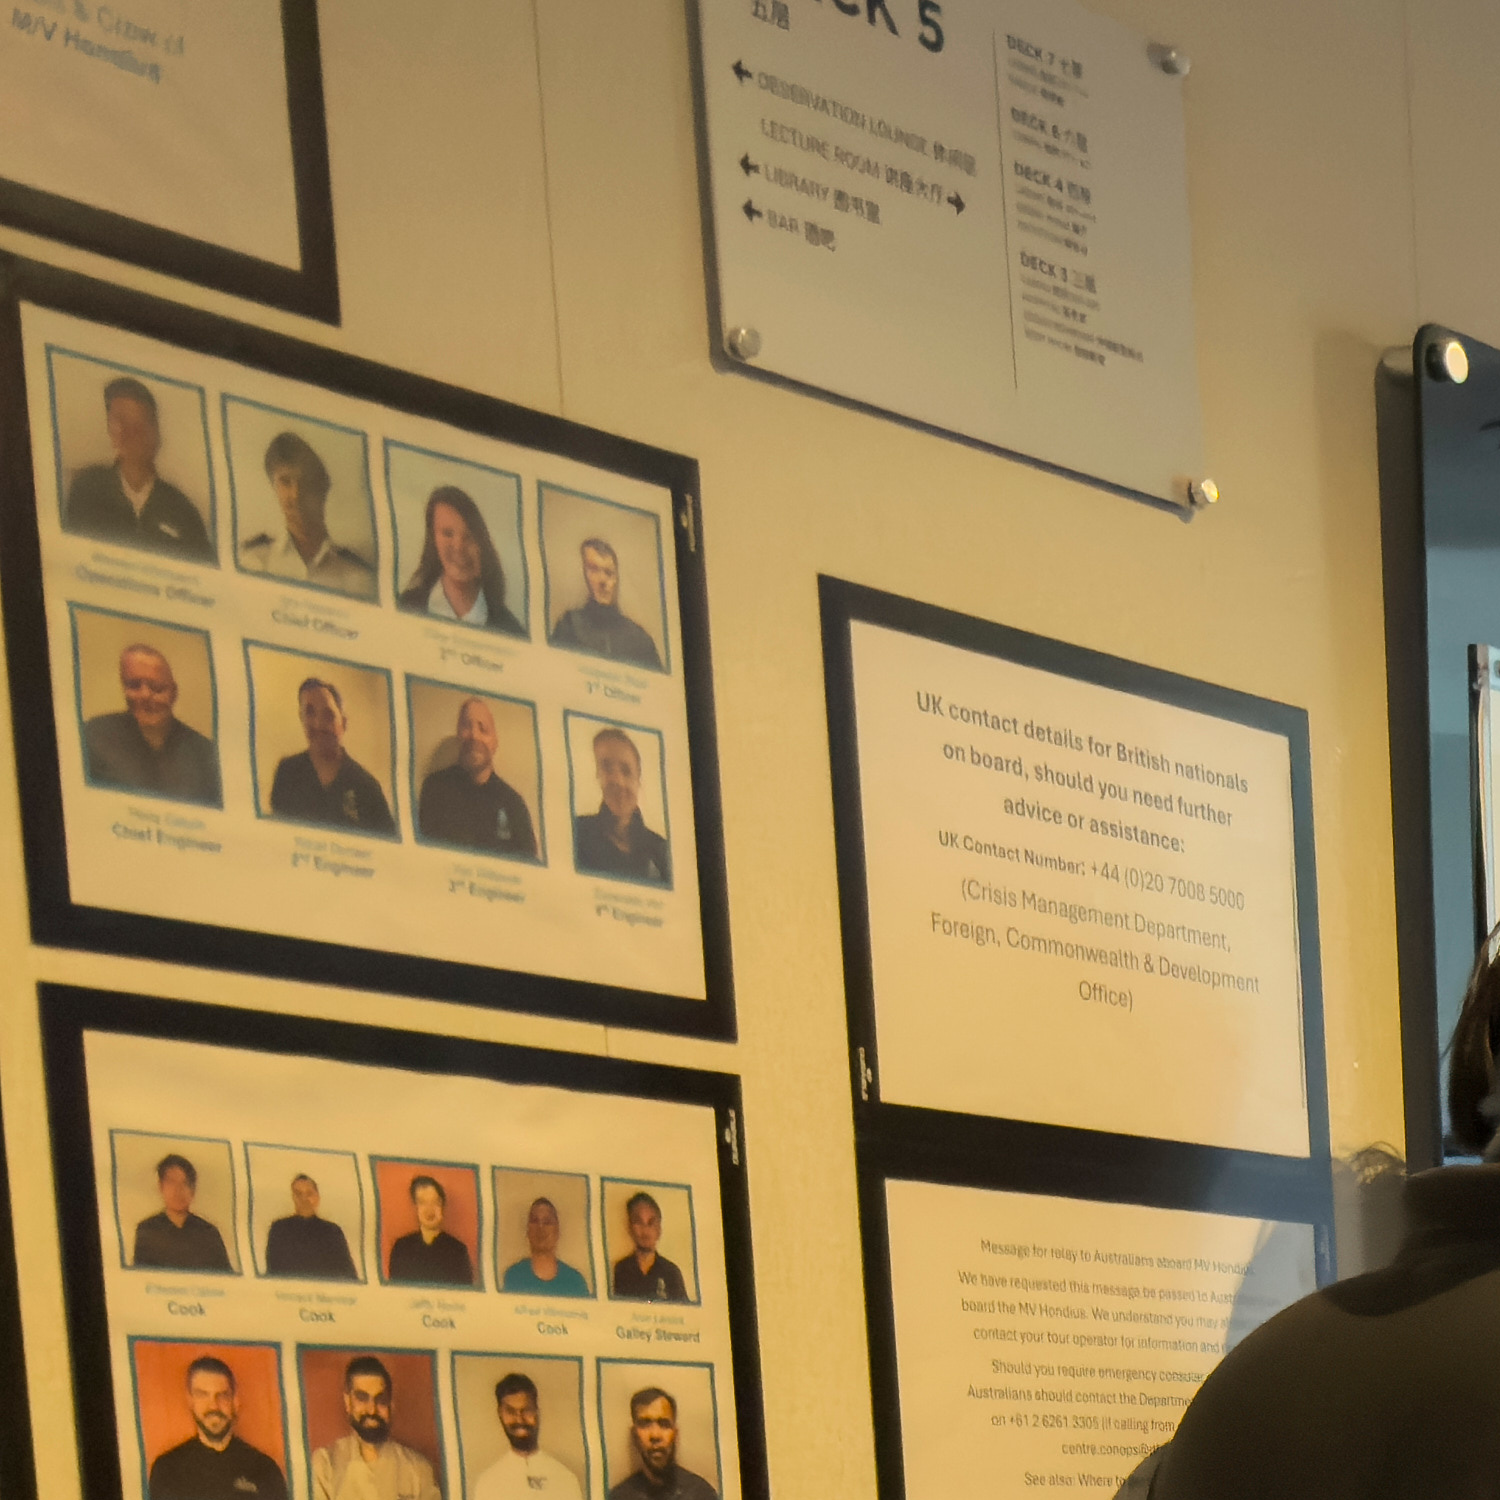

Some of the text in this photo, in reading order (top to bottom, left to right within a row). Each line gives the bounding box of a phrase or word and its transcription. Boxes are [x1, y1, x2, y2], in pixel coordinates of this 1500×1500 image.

[917, 0, 945, 53] 5
[761, 118, 830, 162] LECTURE
[1020, 250, 1056, 278] DECK
[916, 691, 1249, 794] UK contact details for British nationals
[943, 743, 1233, 827] on board, should you need further
[1004, 798, 1185, 853] advice or assistance:
[939, 830, 1245, 912] UK Contact Number: +44 (0)20 7008 5000
[961, 878, 1231, 954] (Crisis Management Department,
[931, 911, 1261, 995] Foreign, Commonwealth & Development
[1078, 980, 1133, 1014] Office)
[980, 1238, 1031, 1260] Message
[1032, 1243, 1049, 1258] for
[1081, 1250, 1091, 1262] to
[1094, 1250, 1154, 1267] Australians
[958, 1270, 977, 1285] We
[981, 1273, 1008, 1288] have
[1010, 1277, 1067, 1293] requested
[1070, 1280, 1090, 1294] this
[1093, 1282, 1140, 1300] message
[1143, 1285, 1156, 1298] be
[167, 1301, 206, 1318] Cook
[299, 1308, 337, 1324] Cook
[422, 1314, 457, 1330] Cook
[961, 1298, 996, 1313] board
[997, 1300, 1016, 1315] the
[1019, 1302, 1037, 1316] MV
[1091, 1307, 1110, 1321] We
[1112, 1310, 1173, 1325] understand
[1176, 1316, 1194, 1329] you
[537, 1321, 569, 1337] Cook
[616, 1325, 652, 1343] Galley
[973, 1327, 1017, 1342] contact
[1019, 1331, 1045, 1345] your
[1047, 1331, 1069, 1345] tour
[1072, 1334, 1118, 1348] operator
[1120, 1335, 1135, 1349] for
[1138, 1336, 1198, 1352] information
[991, 1359, 1032, 1375] Should
[1034, 1364, 1055, 1378] you
[1057, 1364, 1096, 1379] require
[1098, 1367, 1157, 1382] emergency
[967, 1384, 1033, 1401] Australians
[1035, 1388, 1073, 1402] should
[1075, 1391, 1117, 1404] contact
[1119, 1391, 1136, 1403] the
[1024, 1471, 1046, 1486] See
[1078, 1473, 1113, 1487] Where
